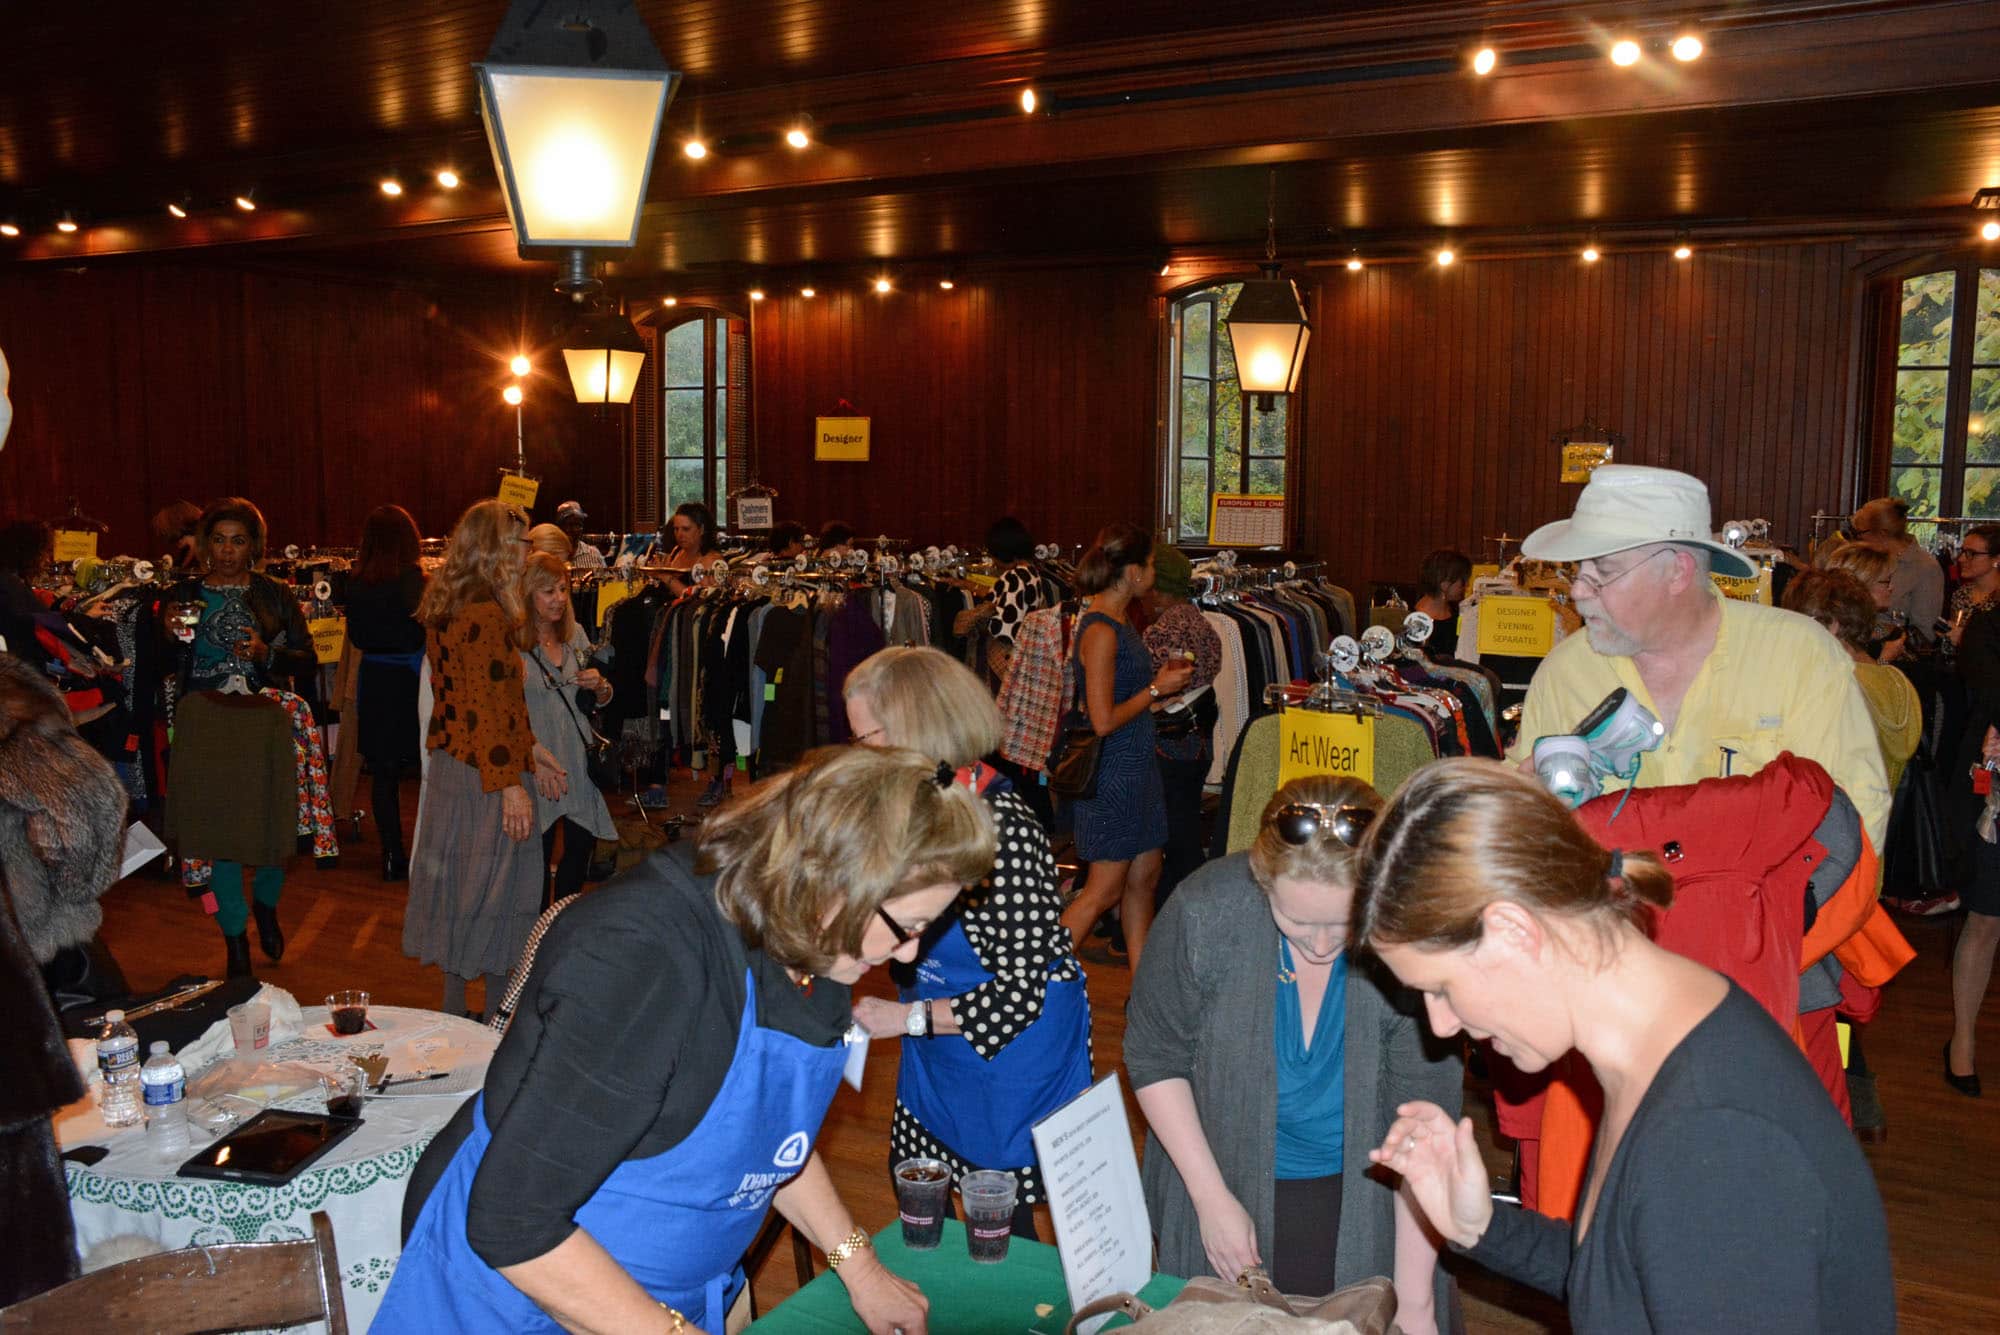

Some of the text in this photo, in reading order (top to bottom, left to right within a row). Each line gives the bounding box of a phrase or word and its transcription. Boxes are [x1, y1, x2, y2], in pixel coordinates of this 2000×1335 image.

[823, 432, 863, 445] Designer
[1219, 500, 1252, 508] EUROPEAN
[1254, 500, 1267, 508] SIZE
[1496, 607, 1537, 616] DESIGNER
[1496, 622, 1534, 631] EVENING
[1493, 634, 1538, 645] SEPARATES
[1289, 731, 1360, 772] Art Wear
